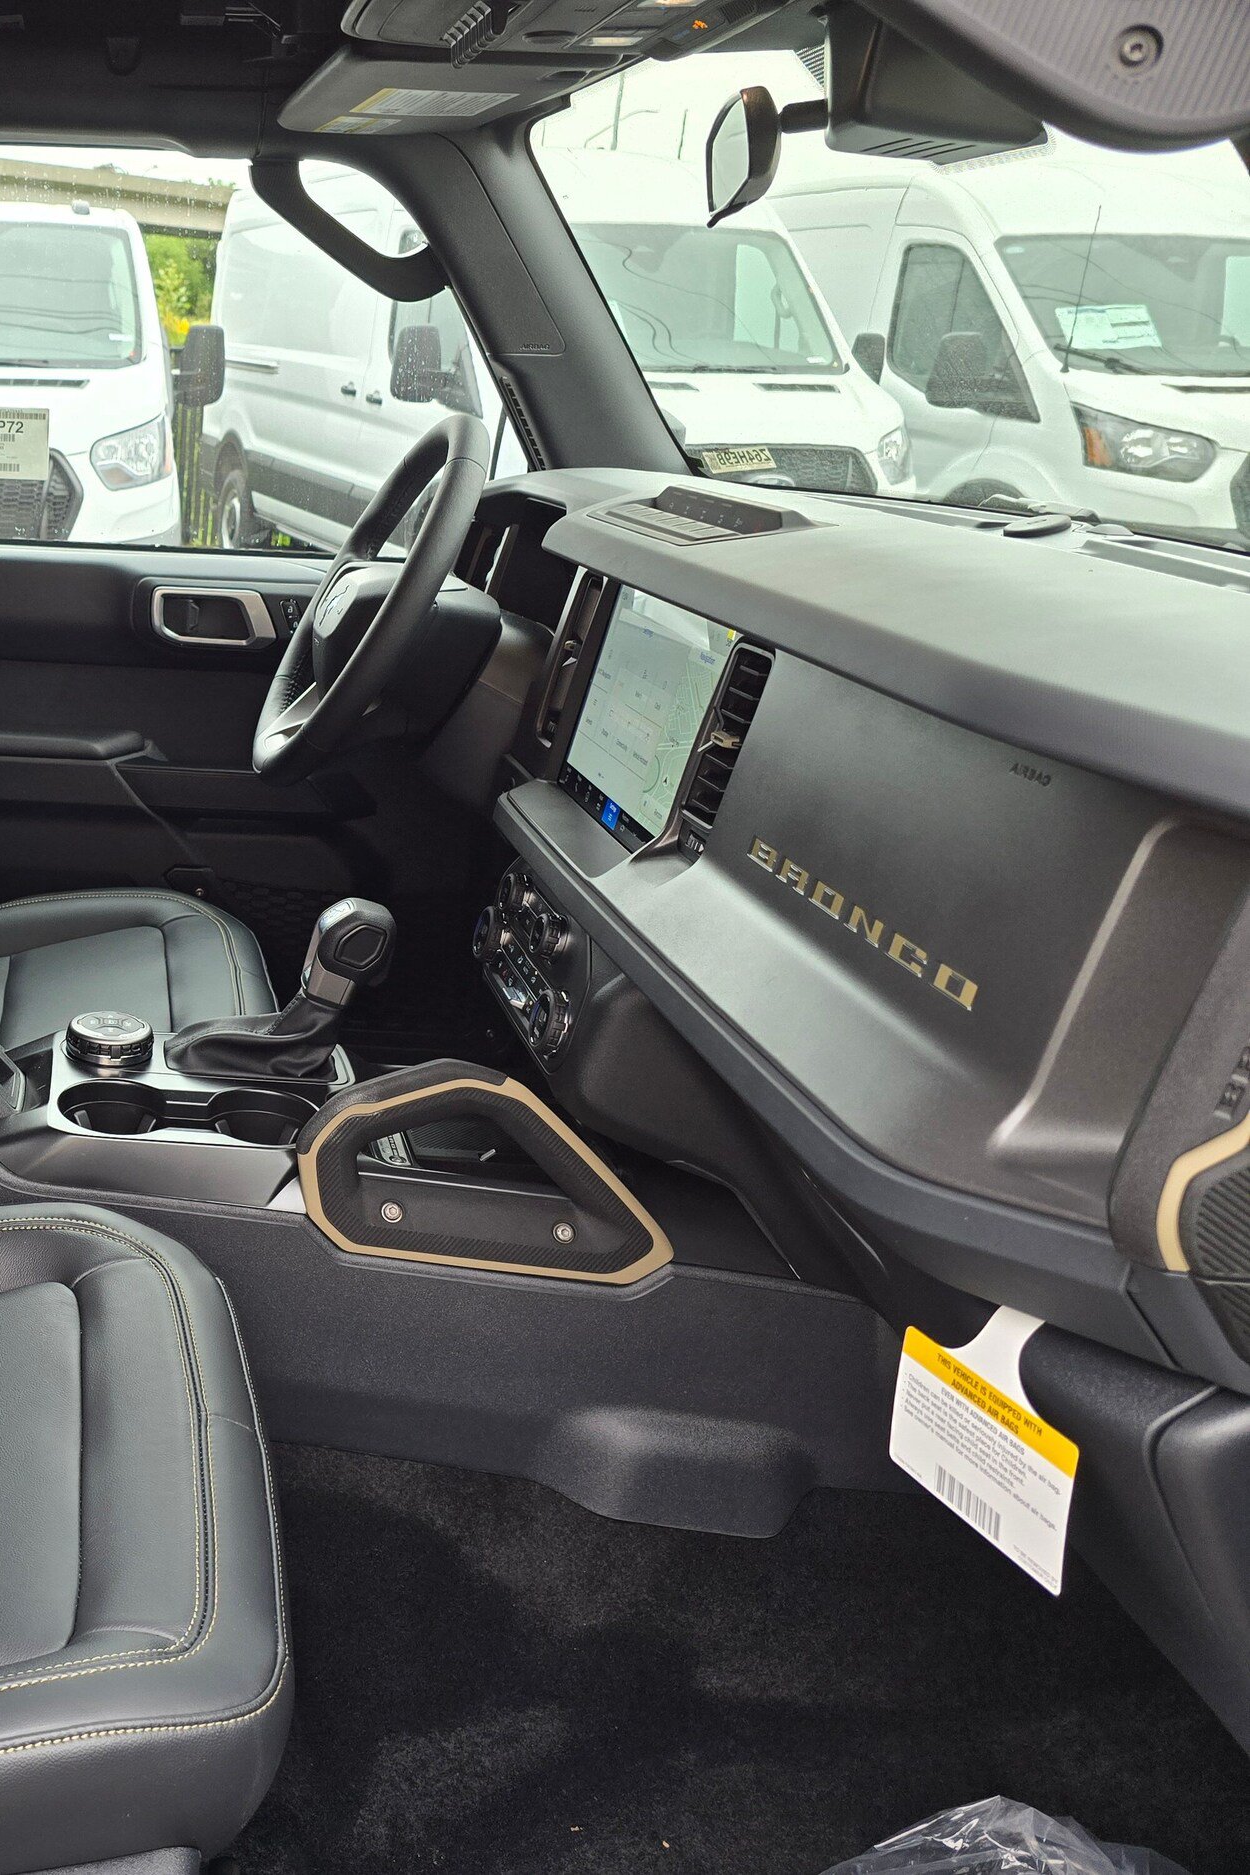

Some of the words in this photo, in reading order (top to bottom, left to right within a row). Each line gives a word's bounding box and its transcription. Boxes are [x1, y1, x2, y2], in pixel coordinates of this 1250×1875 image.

[747, 838, 978, 1011] BRONCO
[907, 1380, 917, 1394] The
[917, 1389, 930, 1403] back
[930, 1400, 942, 1413] seat
[942, 1409, 948, 1417] is
[948, 1413, 958, 1425] the
[958, 1421, 975, 1438] safest
[975, 1435, 991, 1451] place
[991, 1446, 1000, 1457] for
[1001, 1453, 1027, 1479] Children.
[908, 1373, 930, 1395] Children
[930, 1391, 940, 1402] can
[940, 1398, 948, 1408] be
[948, 1404, 963, 1420] killed
[963, 1417, 970, 1425] or
[970, 1422, 997, 1447] seriously
[997, 1441, 1018, 1462] injured
[1018, 1457, 1026, 1469] by
[1027, 1465, 1037, 1477] the
[1038, 1474, 1047, 1484] air
[1047, 1479, 1061, 1496] bag.
[937, 1352, 952, 1370] THIS
[952, 1364, 979, 1391] VEHICLE
[979, 1385, 987, 1397] IS
[987, 1391, 1022, 1422] EQUIPPED
[1023, 1417, 1042, 1437] WITH
[941, 1387, 954, 1402] EVEN
[955, 1398, 969, 1413] WITH
[969, 1409, 998, 1435] ADVANCED
[998, 1431, 1009, 1444] AIR
[1009, 1438, 1025, 1456] BAGS
[950, 1378, 986, 1410] ADVANCED
[986, 1405, 999, 1420] AIR
[1000, 1414, 1019, 1435] BAGS
